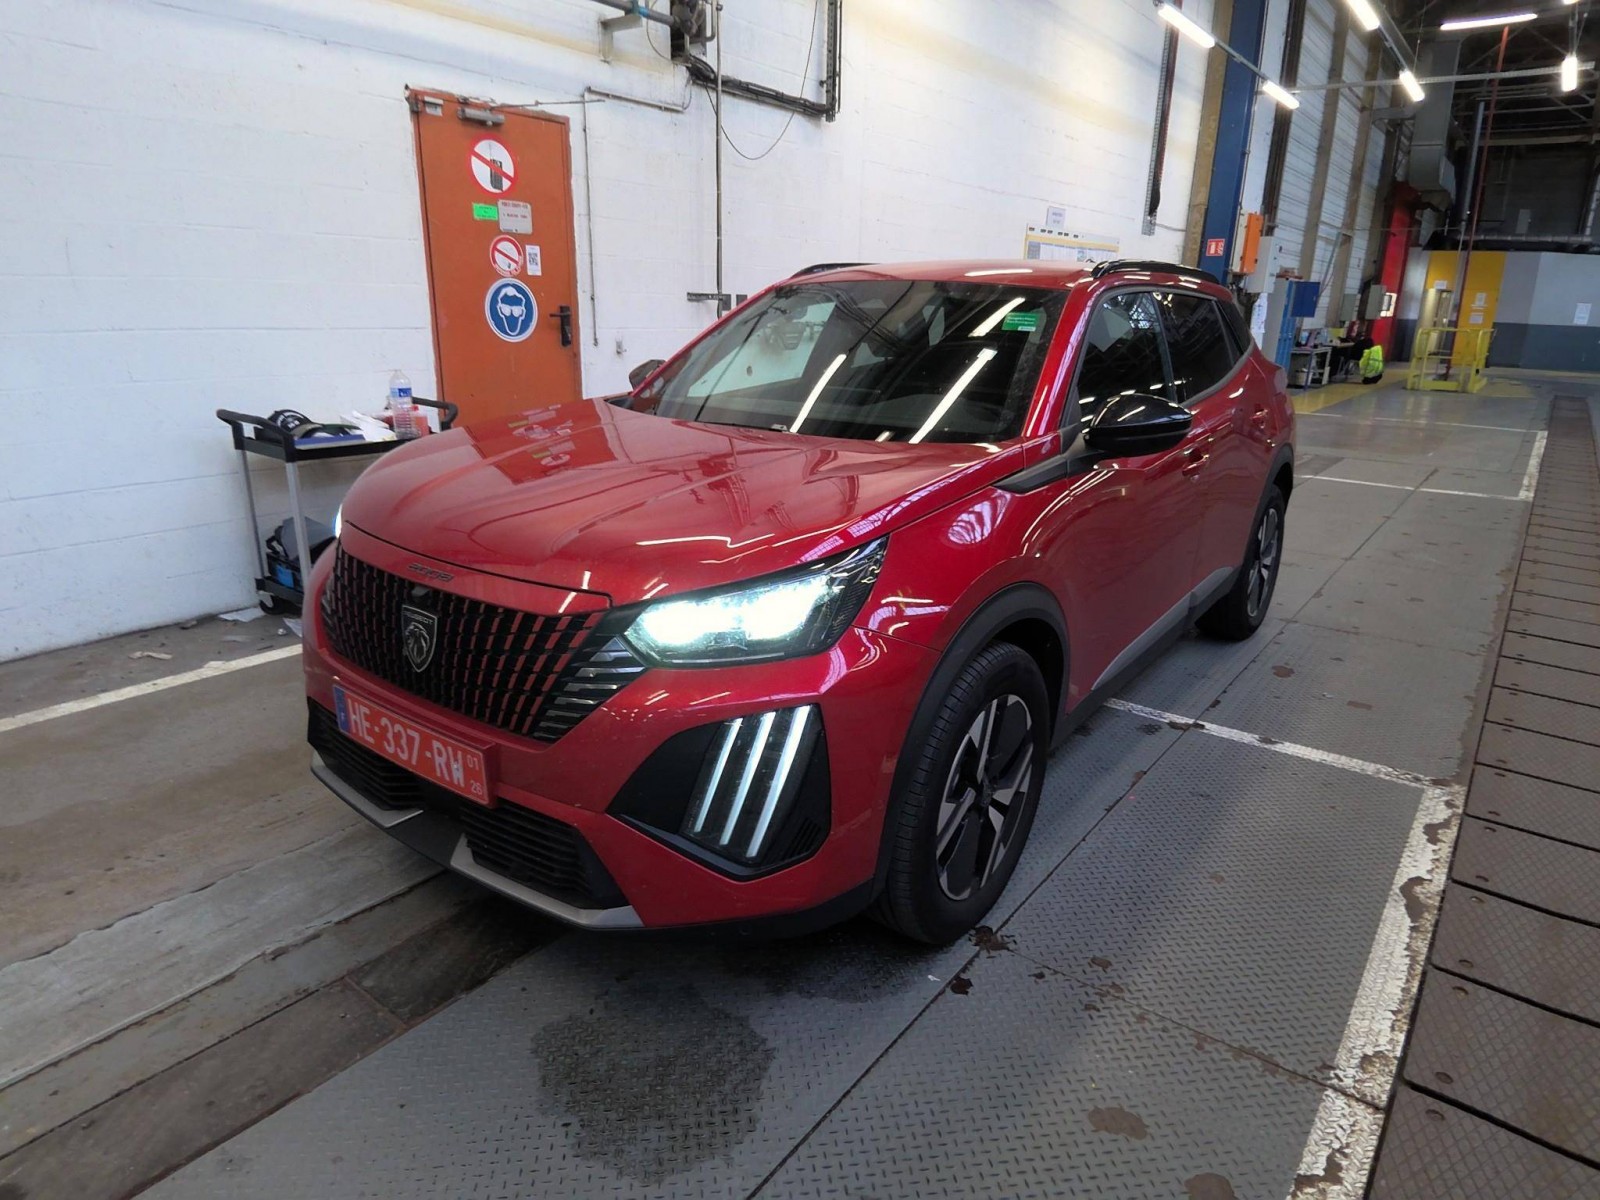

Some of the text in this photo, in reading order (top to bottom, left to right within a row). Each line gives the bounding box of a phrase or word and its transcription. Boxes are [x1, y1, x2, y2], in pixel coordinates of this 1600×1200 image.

[408, 563, 454, 582] 2008
[348, 699, 465, 788] HE-337-RW
[466, 755, 479, 771] 01
[470, 780, 482, 795] 26
